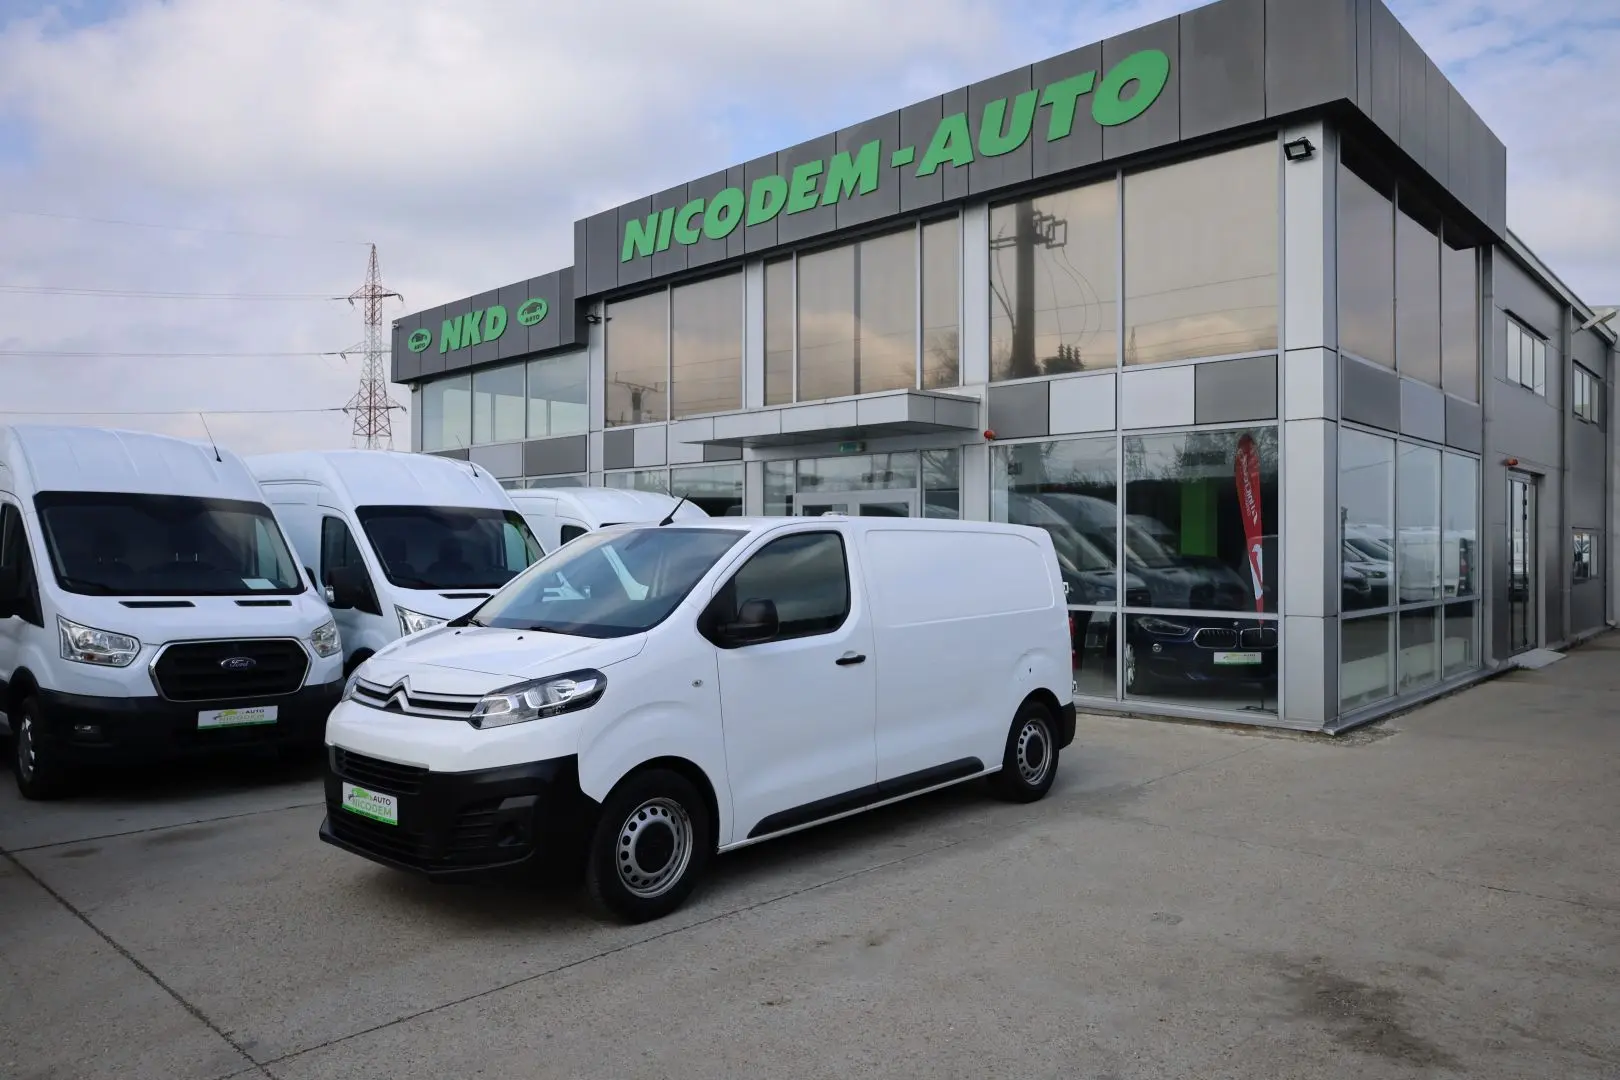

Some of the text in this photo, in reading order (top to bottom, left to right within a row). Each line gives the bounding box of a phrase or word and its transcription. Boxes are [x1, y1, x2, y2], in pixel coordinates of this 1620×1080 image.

[440, 305, 508, 355] NKD
[352, 798, 392, 817] NICODEM
[373, 795, 392, 806] AUTO
